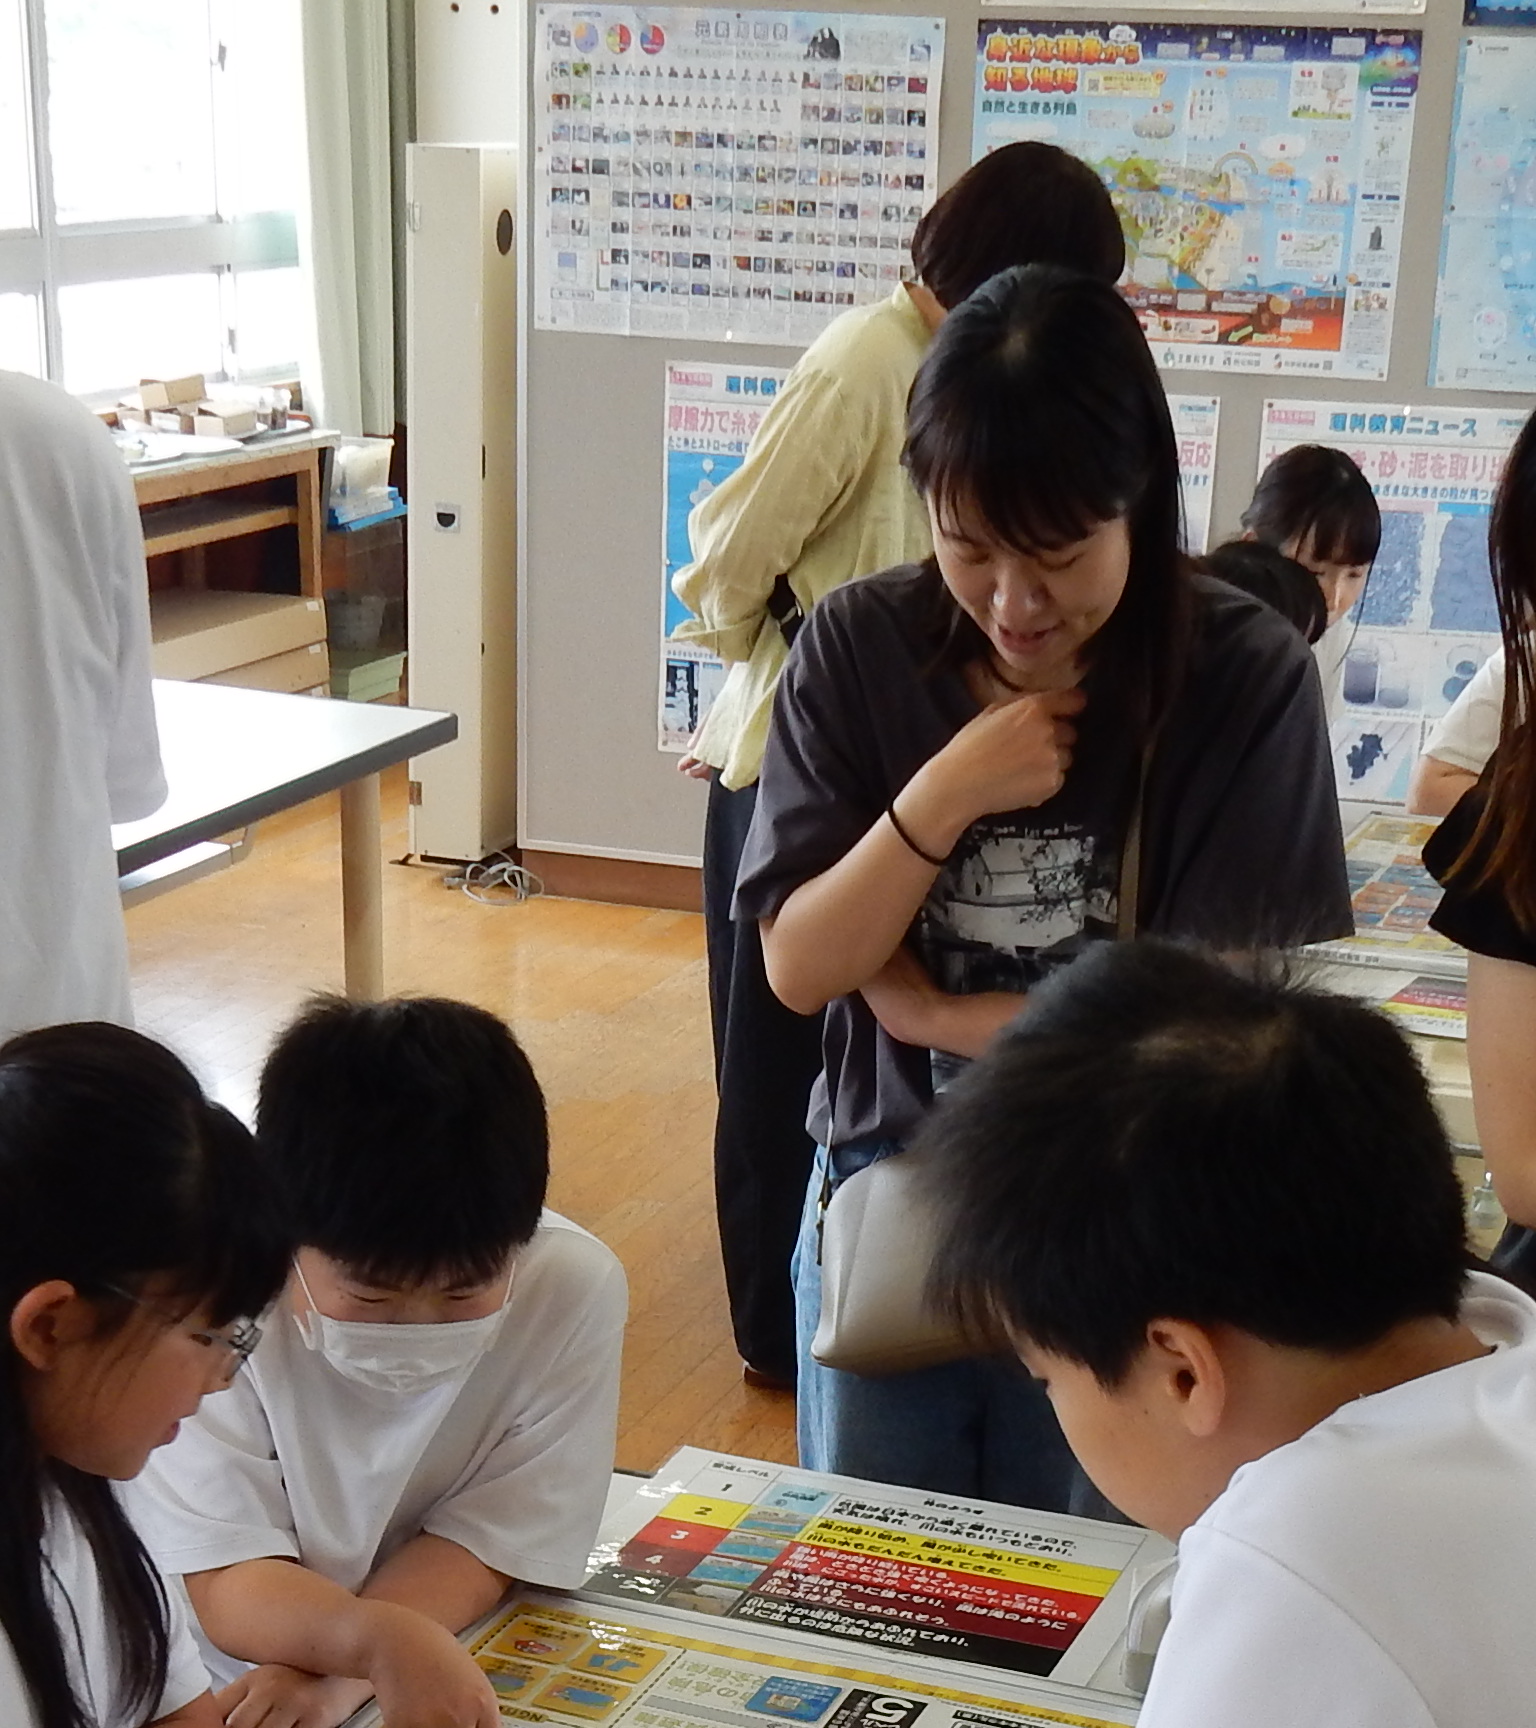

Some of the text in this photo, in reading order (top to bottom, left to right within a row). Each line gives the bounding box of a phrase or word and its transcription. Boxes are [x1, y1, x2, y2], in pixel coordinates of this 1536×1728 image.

[695, 20, 789, 42] 元素周期表
[986, 33, 1142, 64] 身近な現象から
[983, 66, 1079, 94] 知る地球
[981, 100, 1078, 116] 自然と生きる列島
[1329, 412, 1478, 438] 理科教育ニュース
[721, 1483, 733, 1492] 1
[694, 1506, 713, 1517] 2
[670, 1530, 690, 1541] 3
[645, 1554, 663, 1565] 4
[865, 1696, 915, 1722] 5
